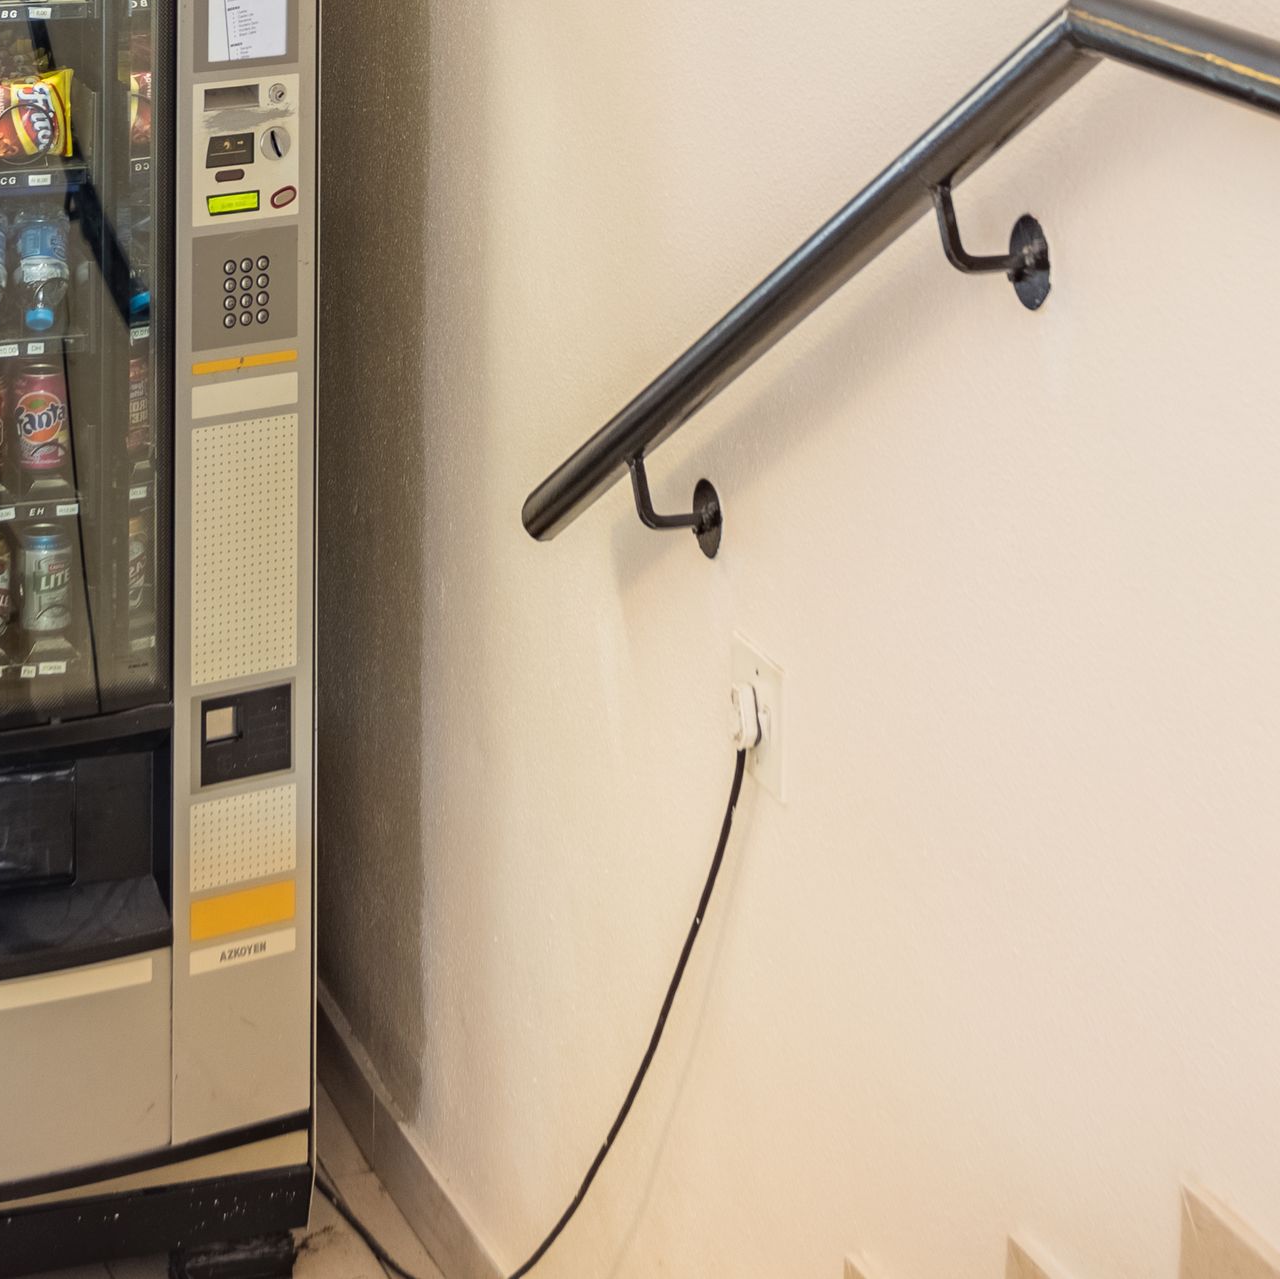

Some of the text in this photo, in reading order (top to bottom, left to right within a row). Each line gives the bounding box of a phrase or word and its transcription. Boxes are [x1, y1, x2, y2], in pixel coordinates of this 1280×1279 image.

[0, 9, 18, 19] BG
[0, 176, 17, 186] CG
[29, 507, 45, 517] EH
[40, 570, 71, 592] LITE
[219, 942, 267, 962] AZKOYEN
